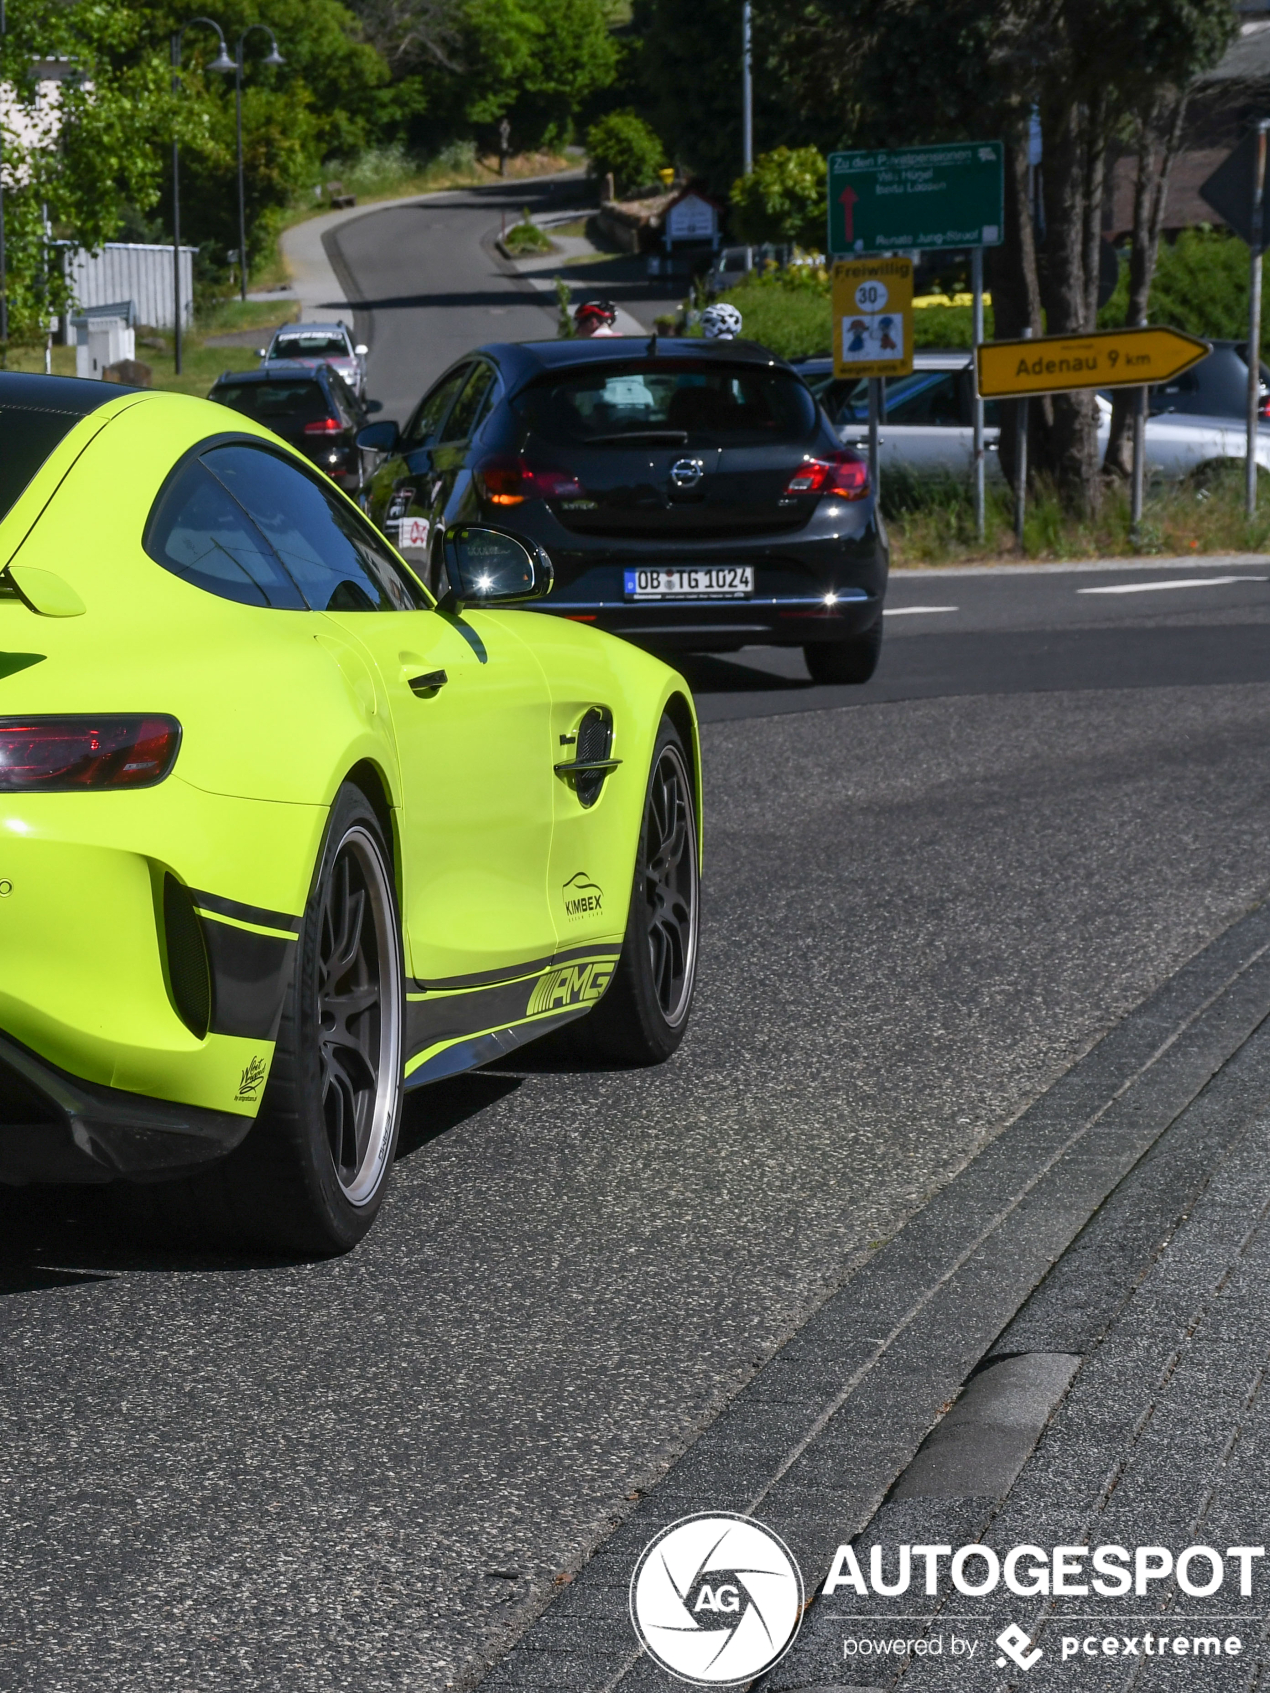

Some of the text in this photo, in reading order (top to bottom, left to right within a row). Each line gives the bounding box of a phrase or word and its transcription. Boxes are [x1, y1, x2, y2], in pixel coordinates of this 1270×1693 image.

[835, 263, 910, 279] Freiwillig
[858, 286, 878, 304] 30
[1015, 350, 1151, 377] Adenau 9 km
[638, 568, 750, 591] OB TG 1024
[565, 894, 602, 917] KIMBEX
[546, 962, 615, 1010] AMG
